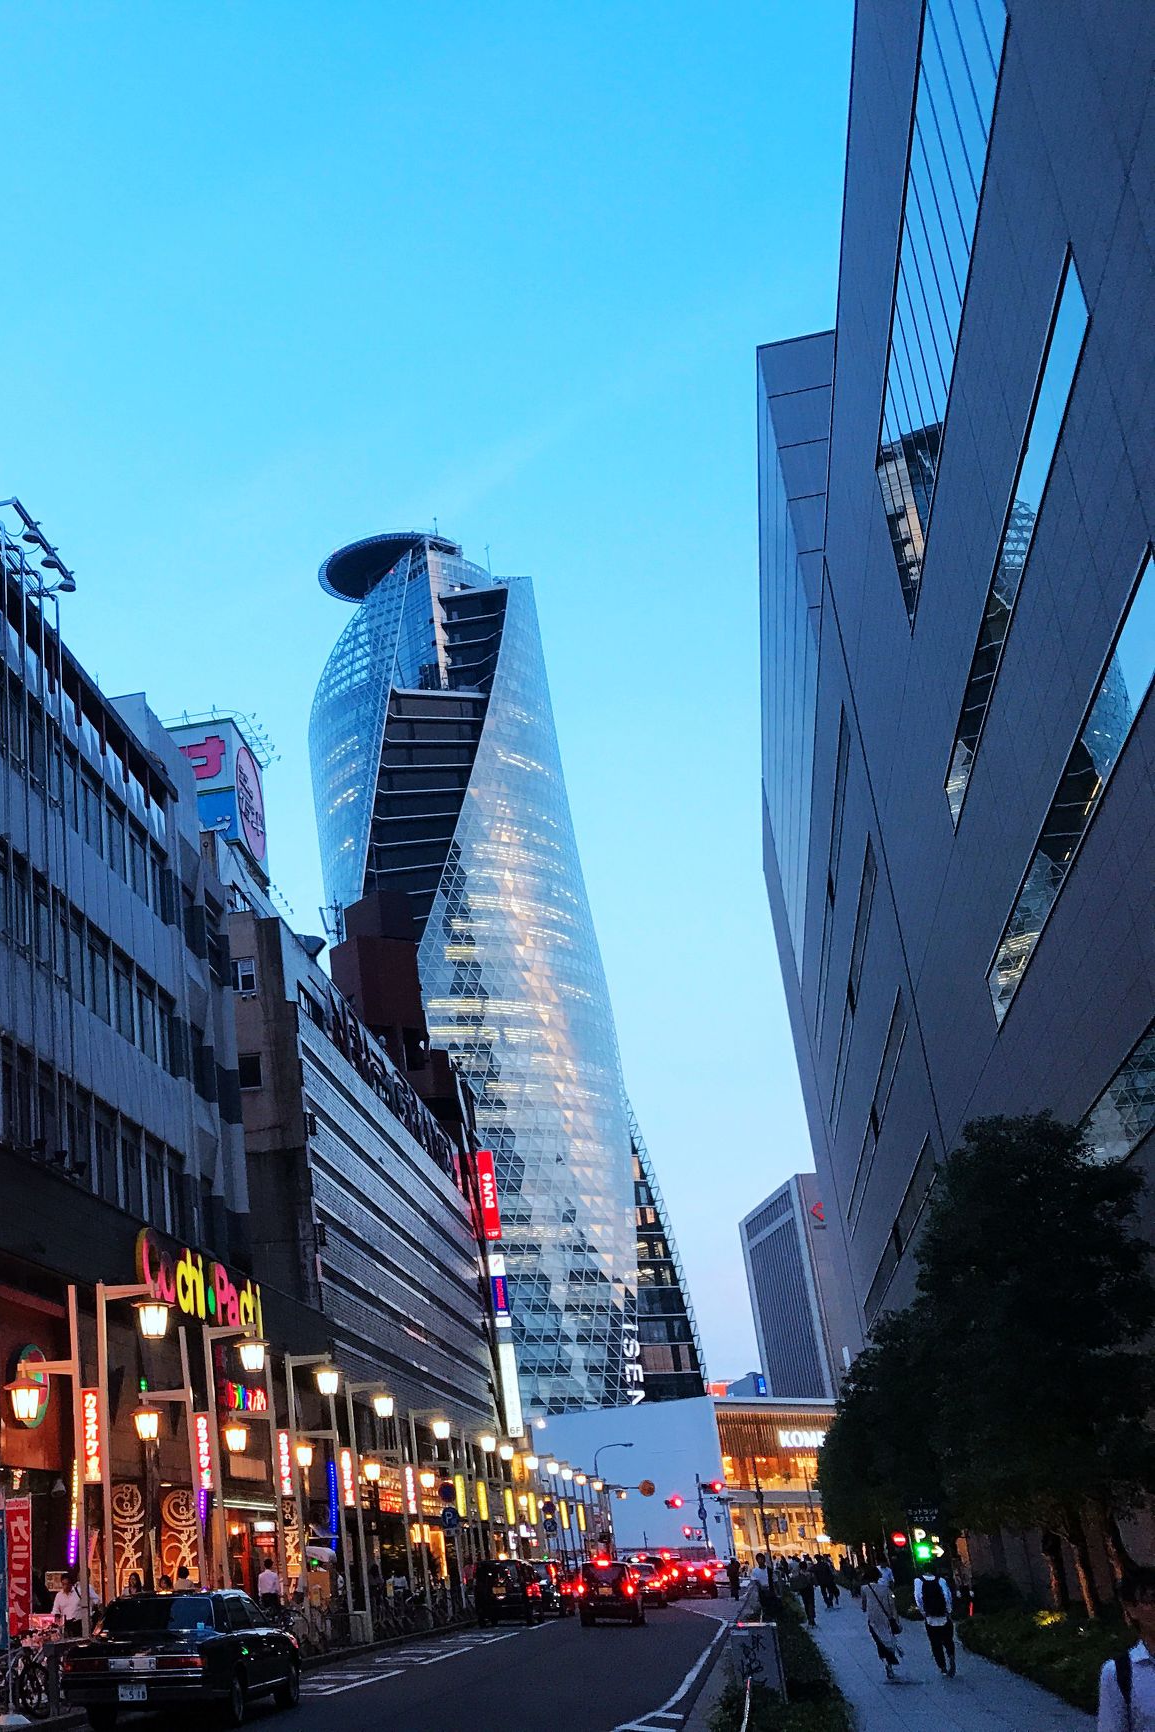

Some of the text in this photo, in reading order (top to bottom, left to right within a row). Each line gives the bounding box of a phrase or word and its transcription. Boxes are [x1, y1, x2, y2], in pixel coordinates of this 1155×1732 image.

[84, 1393, 99, 1456] カラオケ
[509, 1426, 521, 1435] 6F
[914, 1528, 927, 1543] P
